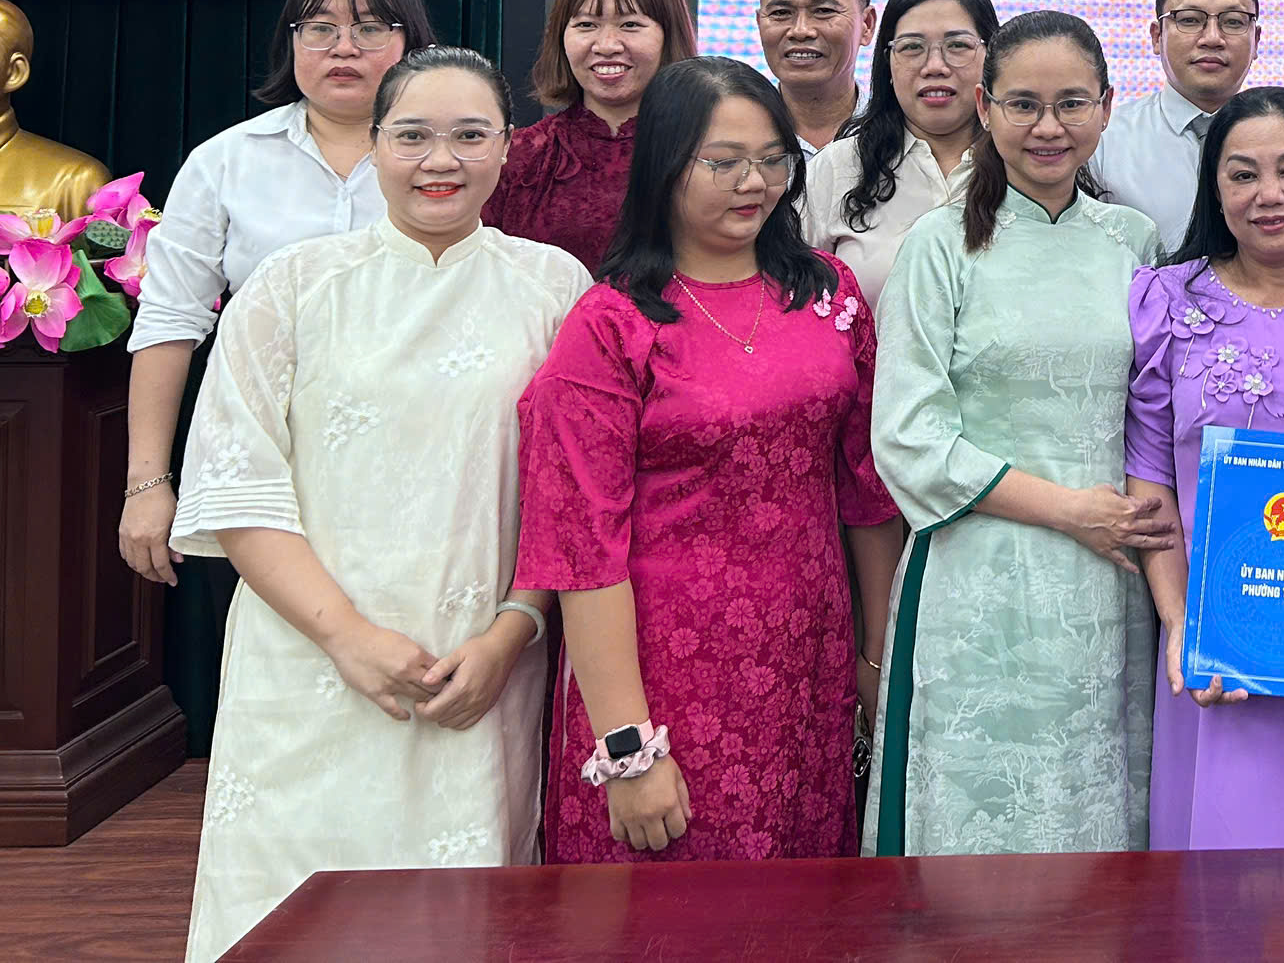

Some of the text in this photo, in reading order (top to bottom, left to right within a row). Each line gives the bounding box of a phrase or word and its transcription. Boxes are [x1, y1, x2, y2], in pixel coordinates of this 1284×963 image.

[1233, 456, 1248, 466] BAN
[1247, 457, 1267, 468] NHÂN
[1267, 458, 1282, 469] DÂN
[1240, 563, 1253, 578] ỦY
[1255, 567, 1275, 580] BAN
[1241, 583, 1281, 598] PHƯỜNG
